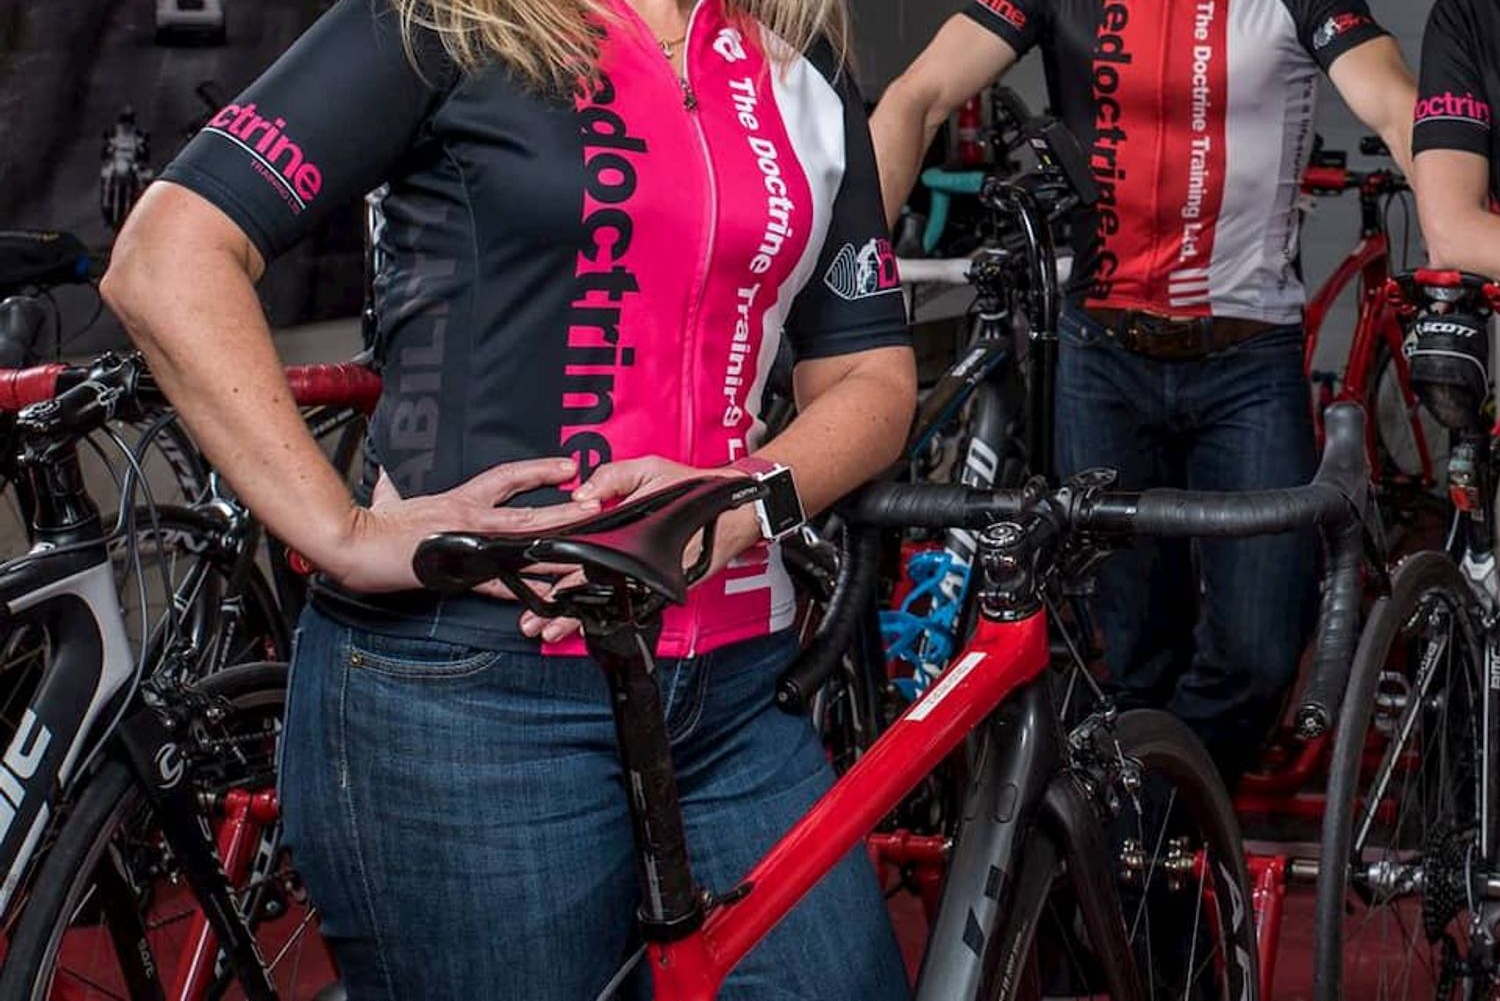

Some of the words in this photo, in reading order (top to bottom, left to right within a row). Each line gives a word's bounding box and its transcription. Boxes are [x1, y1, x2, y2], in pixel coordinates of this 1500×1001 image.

[1194, 1, 1214, 40] The
[1191, 46, 1212, 131] Doctrine
[727, 77, 758, 131] The
[747, 130, 797, 274] Doctrine
[1180, 137, 1211, 219] Training
[1423, 322, 1477, 338] SCOTT
